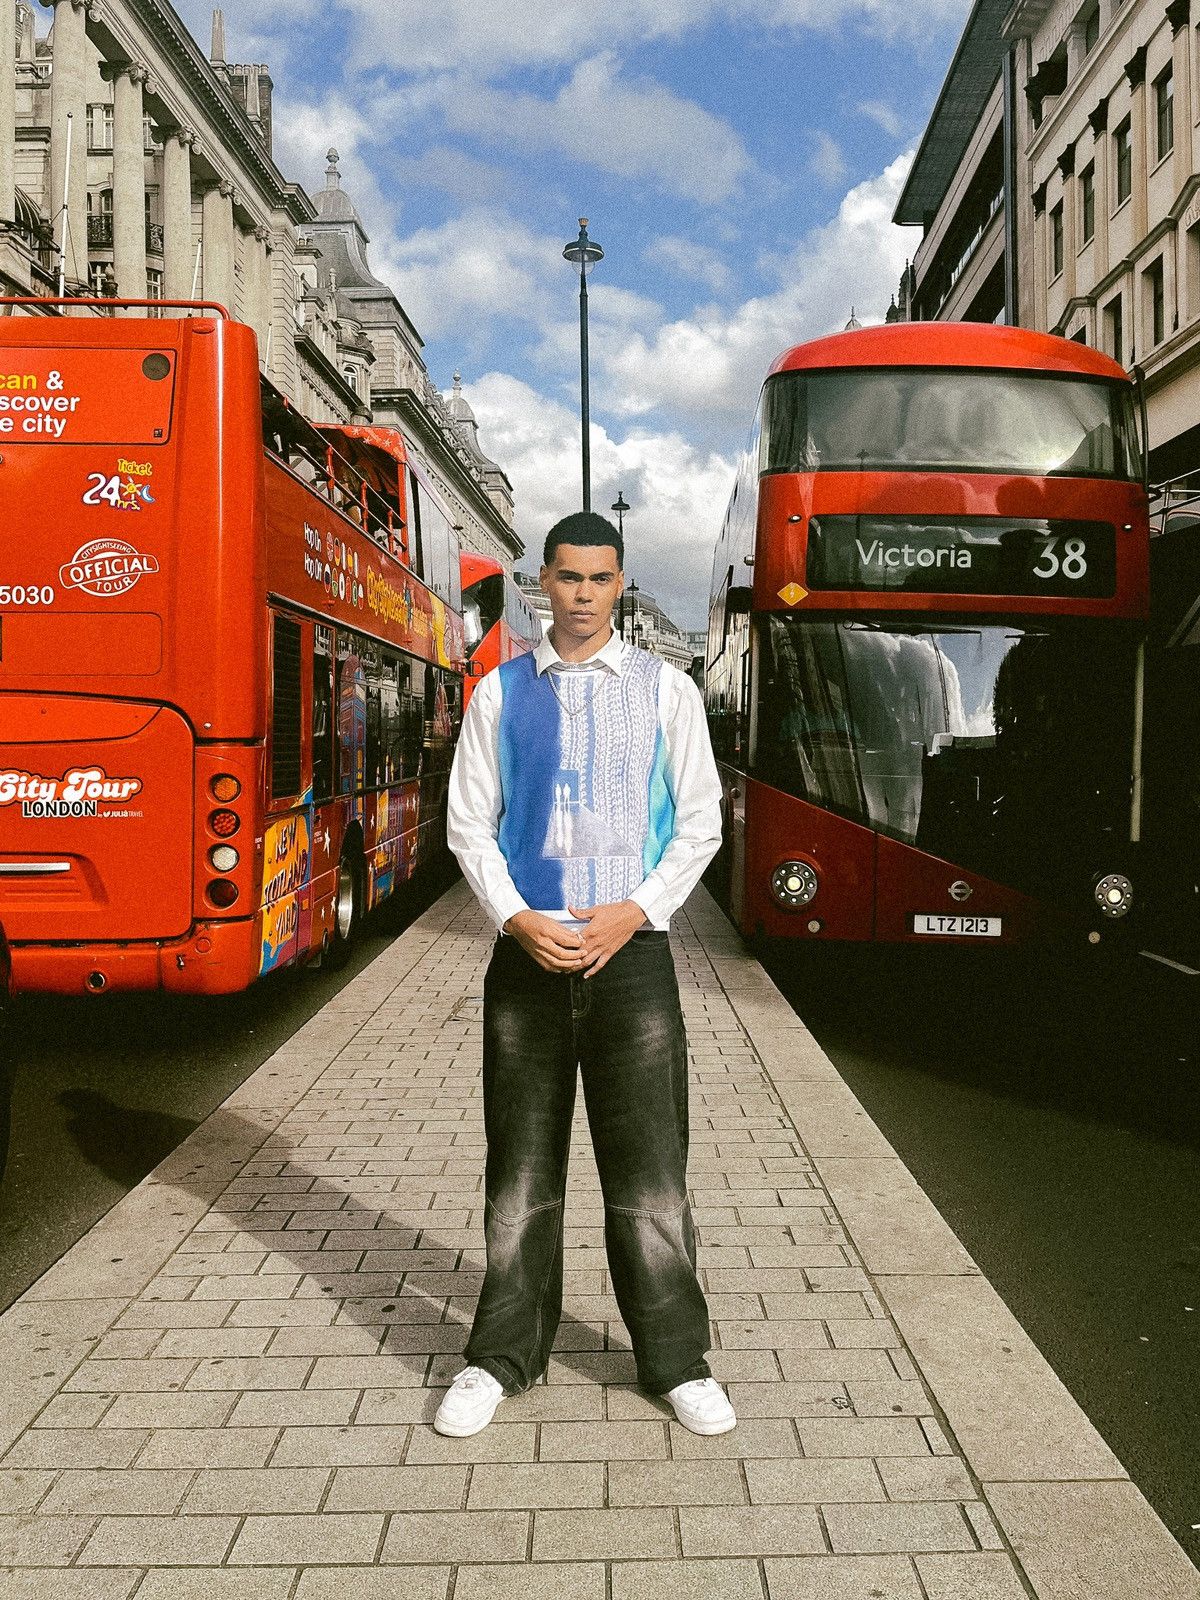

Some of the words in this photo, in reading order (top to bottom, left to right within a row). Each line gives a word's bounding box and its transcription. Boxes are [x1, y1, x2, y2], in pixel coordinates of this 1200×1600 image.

[46, 370, 64, 390] &
[22, 413, 67, 438] city
[117, 458, 153, 476] Ticket
[82, 473, 120, 506] 24
[304, 521, 314, 549] Hop
[315, 529, 321, 552] On
[70, 557, 153, 583] OFFICIAL
[304, 552, 314, 579] Hop
[855, 539, 973, 569] Victoria
[1032, 536, 1088, 579] 38
[0, 585, 54, 605] 5030
[96, 576, 133, 592] TOUR
[0, 773, 57, 800] City
[63, 770, 138, 800] Tour
[23, 801, 97, 817] LONDON
[275, 823, 297, 863] NEW
[926, 917, 957, 932] LTZ
[960, 918, 989, 933] 1213
